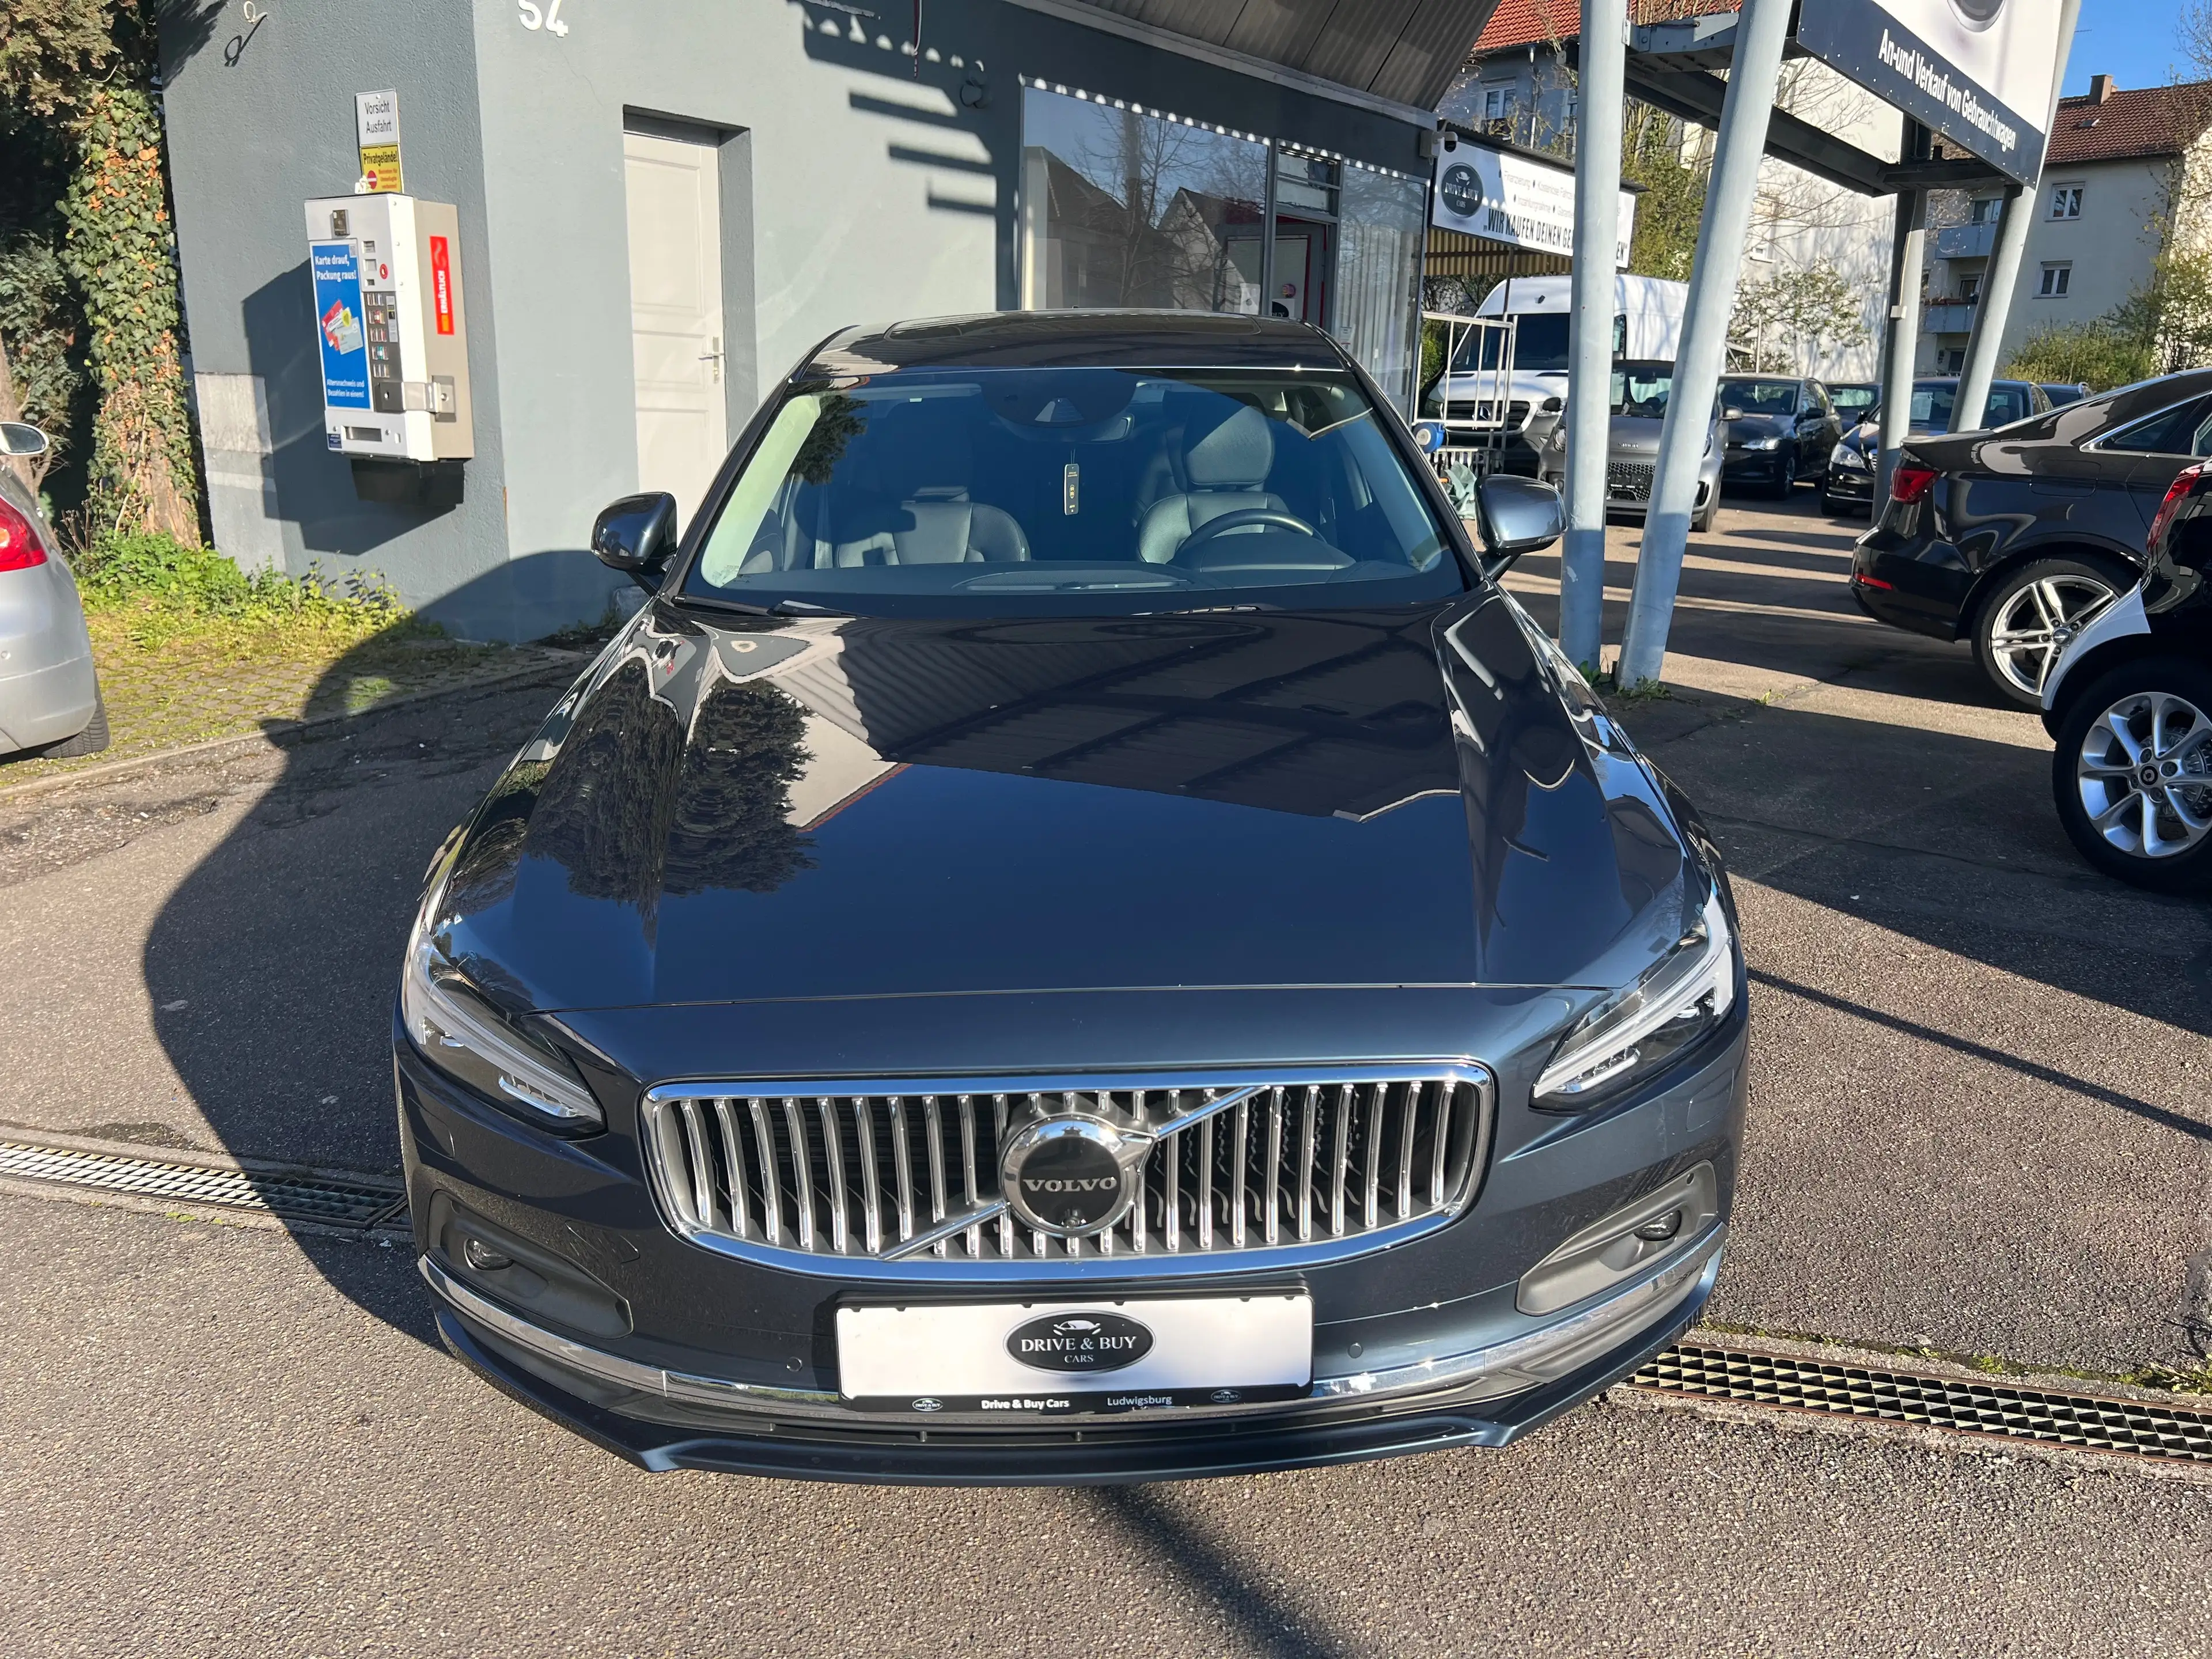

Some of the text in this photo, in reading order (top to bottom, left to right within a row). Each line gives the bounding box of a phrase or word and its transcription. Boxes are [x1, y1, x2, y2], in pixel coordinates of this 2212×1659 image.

[1878, 29, 2016, 152] An-und Verkauf von Gebrauchtwagen
[365, 100, 390, 115] Vorsicht
[366, 120, 392, 134] Ausfahrt
[1505, 214, 1534, 241] KAUFEN
[1536, 220, 1561, 247] DEINEN
[315, 254, 350, 267] Karte drauf,
[316, 270, 357, 282] Packung raus!
[1022, 1177, 1118, 1192] VOLVO
[1021, 1336, 1137, 1352] DRIVE & BUY
[1064, 1354, 1094, 1363] CARS
[981, 1399, 1070, 1410] Drive & Buy Cars
[1107, 1395, 1173, 1407] Ludwigsburg
